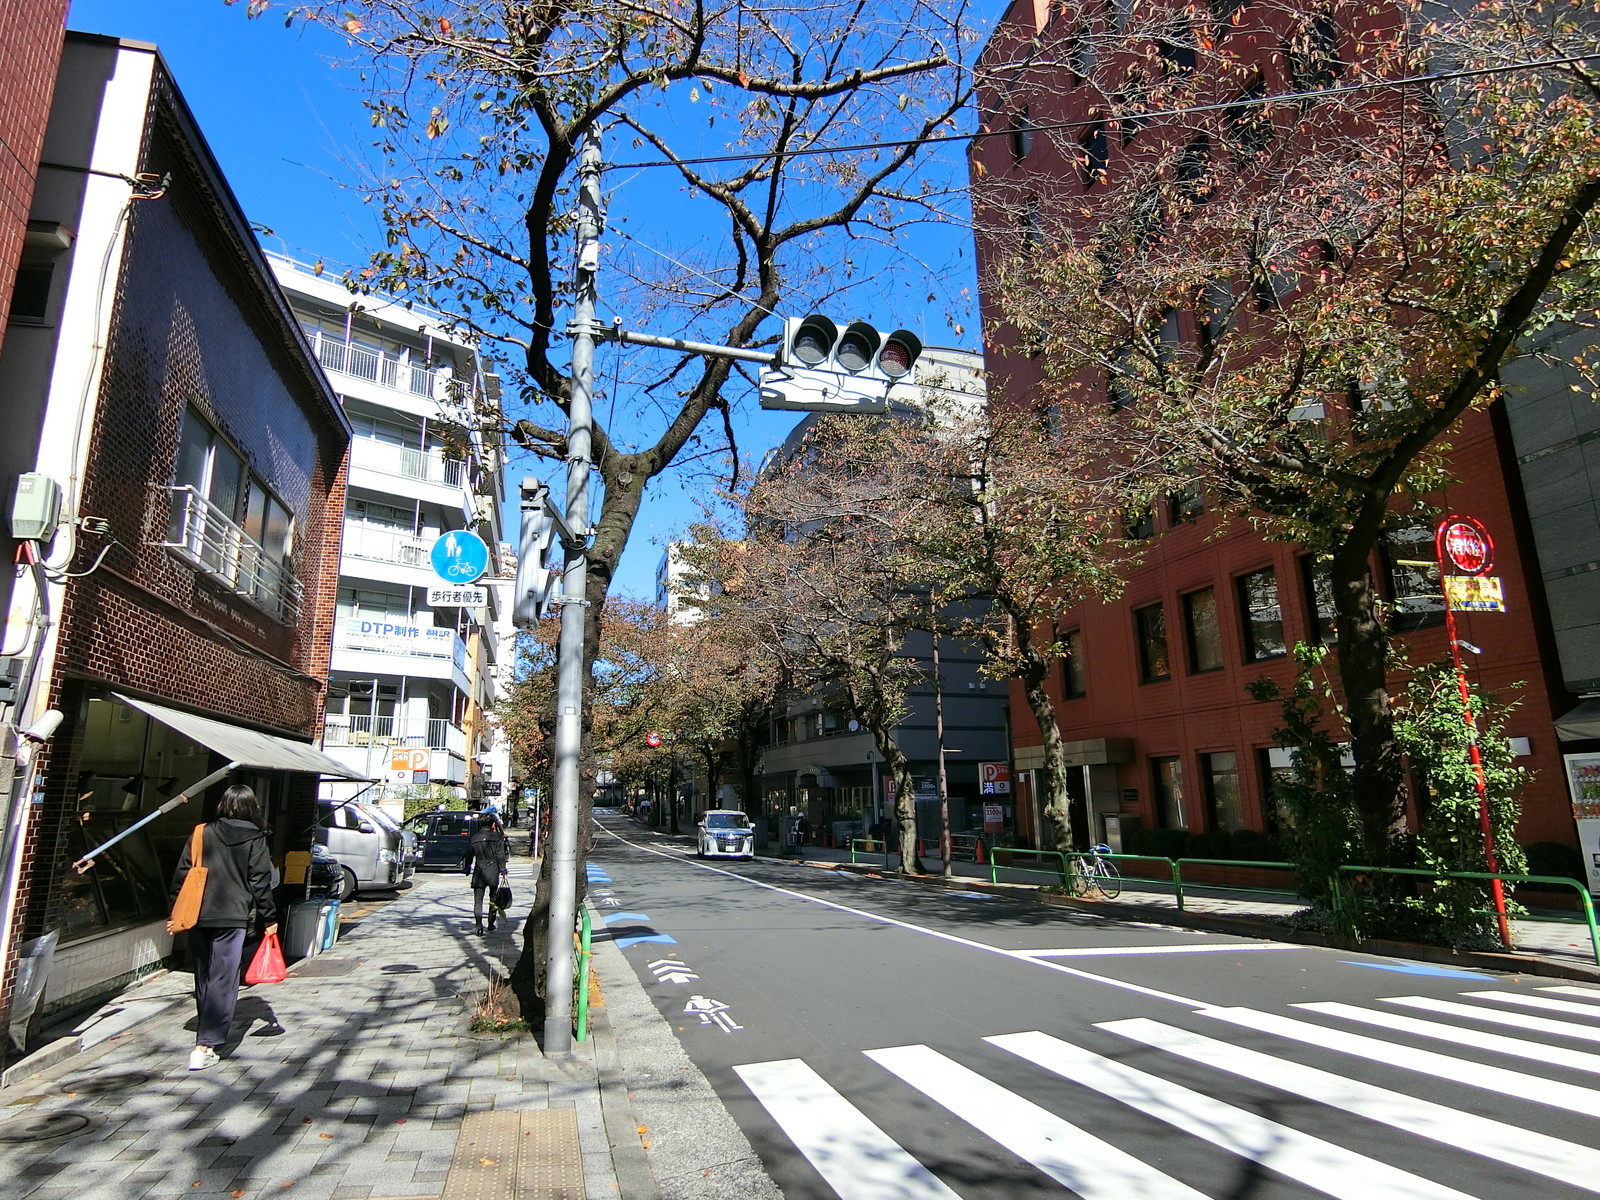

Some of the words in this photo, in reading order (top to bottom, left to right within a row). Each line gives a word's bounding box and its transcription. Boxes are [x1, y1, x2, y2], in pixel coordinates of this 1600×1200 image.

[432, 591, 482, 603] 歩行者優先
[361, 621, 419, 638] DTP制作
[409, 750, 429, 770] P
[983, 764, 998, 781] P
[983, 782, 995, 794] 満
